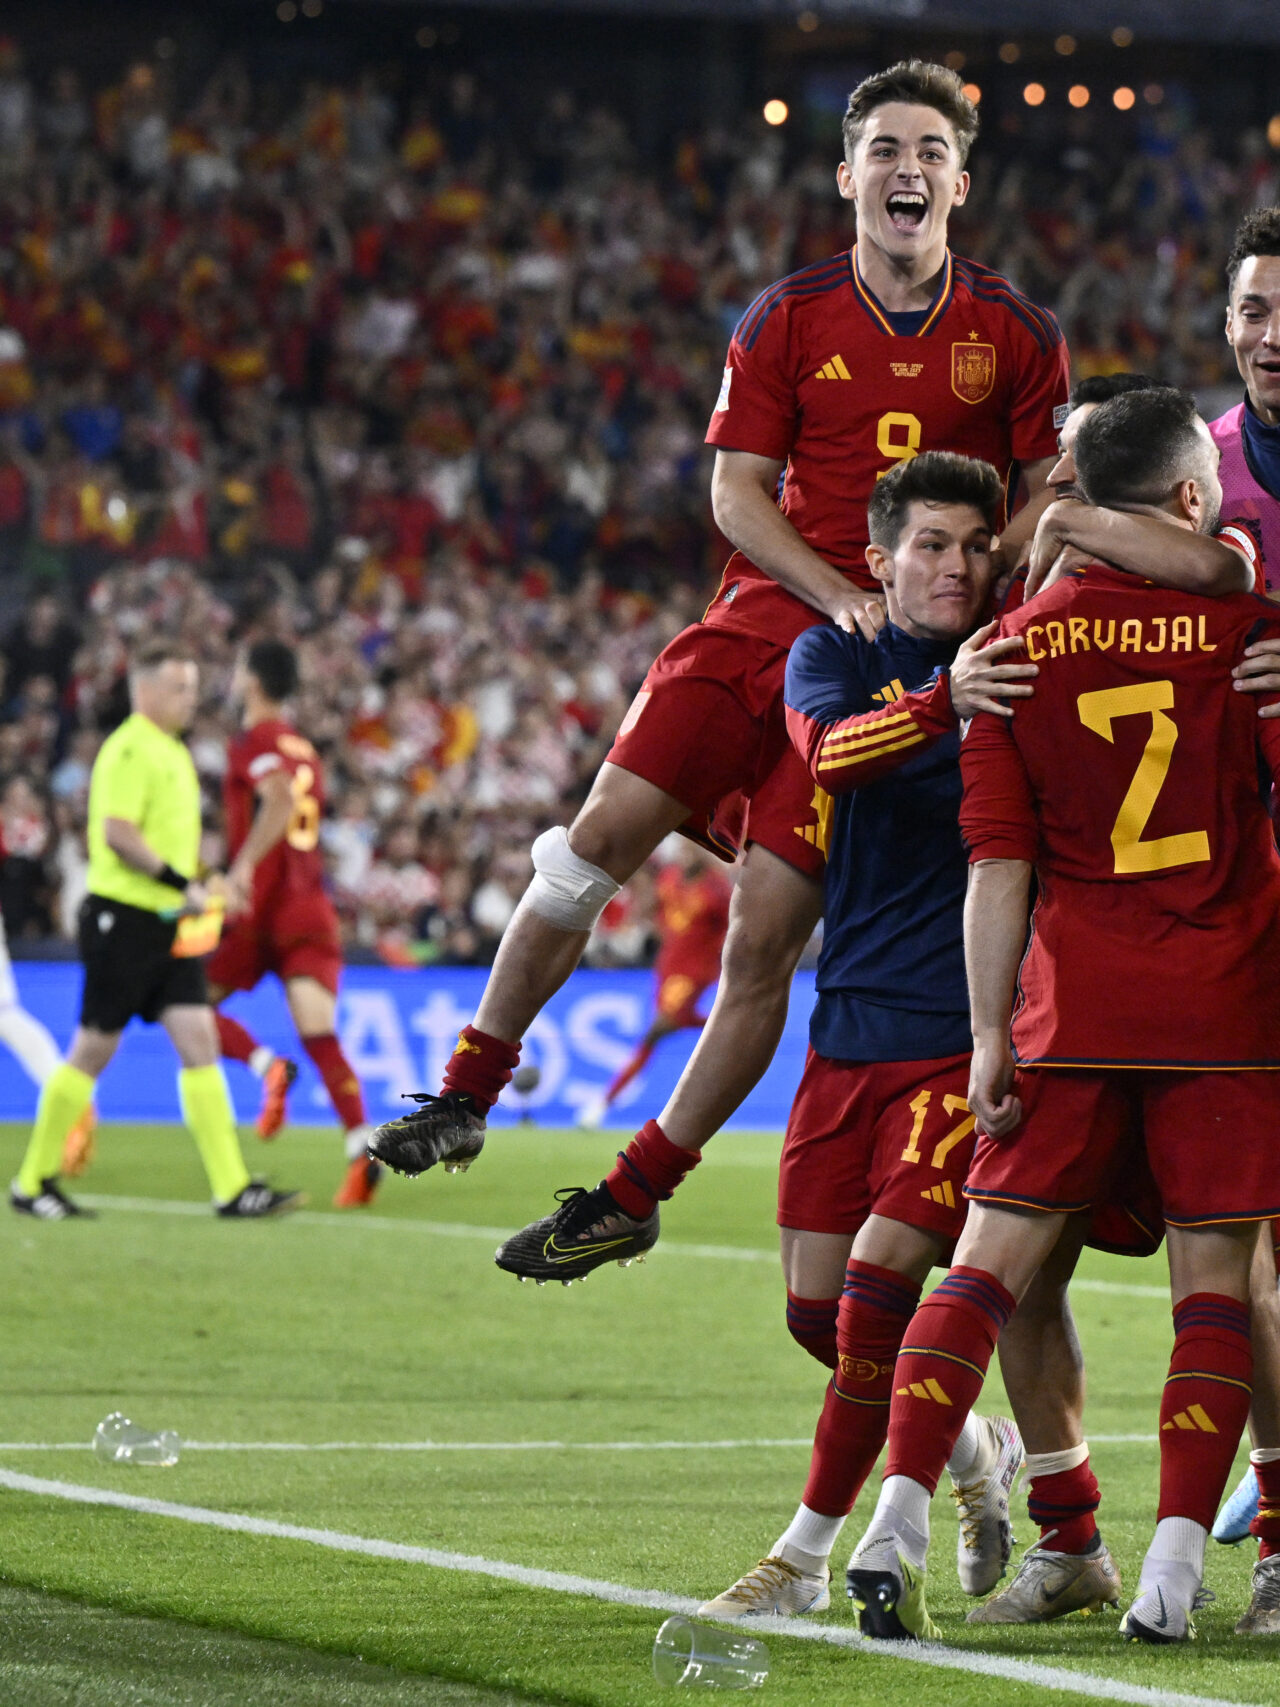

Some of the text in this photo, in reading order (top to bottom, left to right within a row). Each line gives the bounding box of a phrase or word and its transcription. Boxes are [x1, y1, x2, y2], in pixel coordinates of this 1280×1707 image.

[876, 412, 921, 481] 9
[1026, 615, 1217, 661] CARVAJAL
[1077, 680, 1211, 874] 2
[900, 1089, 976, 1169] 17
